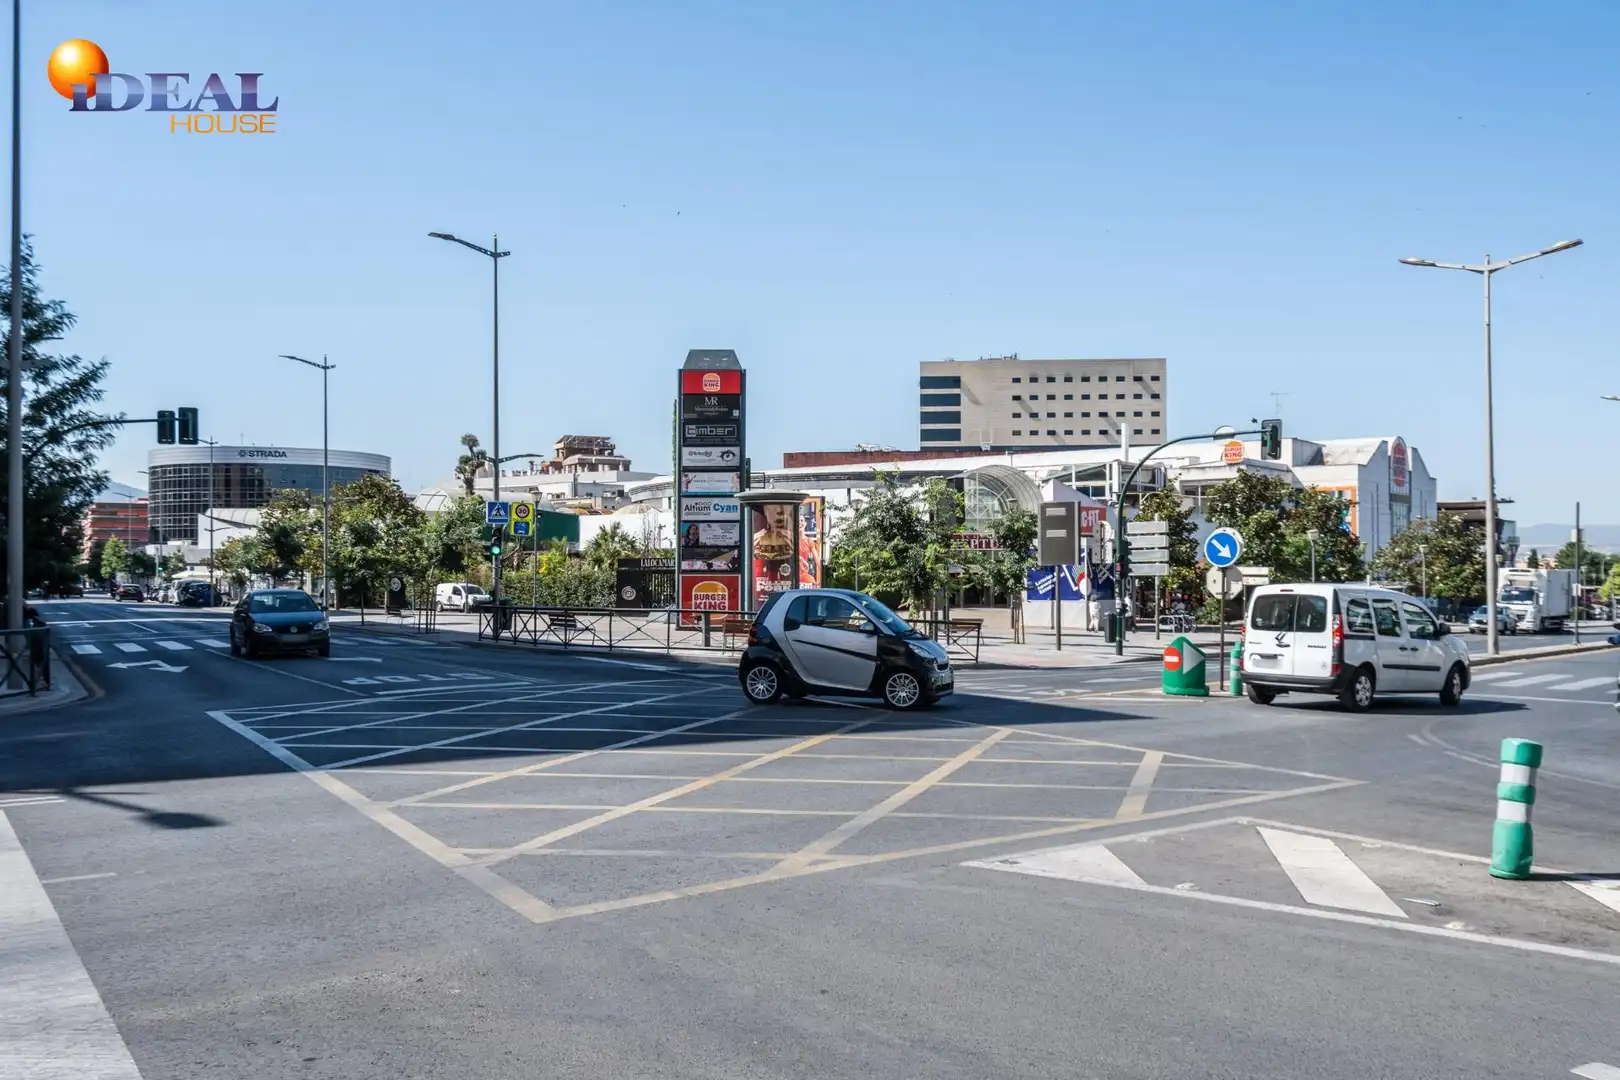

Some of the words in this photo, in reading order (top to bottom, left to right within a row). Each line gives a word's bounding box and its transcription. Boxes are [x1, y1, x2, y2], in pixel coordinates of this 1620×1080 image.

[704, 397, 718, 405] MR
[248, 450, 287, 458] STRADA
[684, 504, 711, 512] Altium
[713, 503, 738, 513] Cyan
[694, 593, 727, 601] BURGER
[694, 601, 727, 610] KING
[341, 673, 496, 685] STOP
